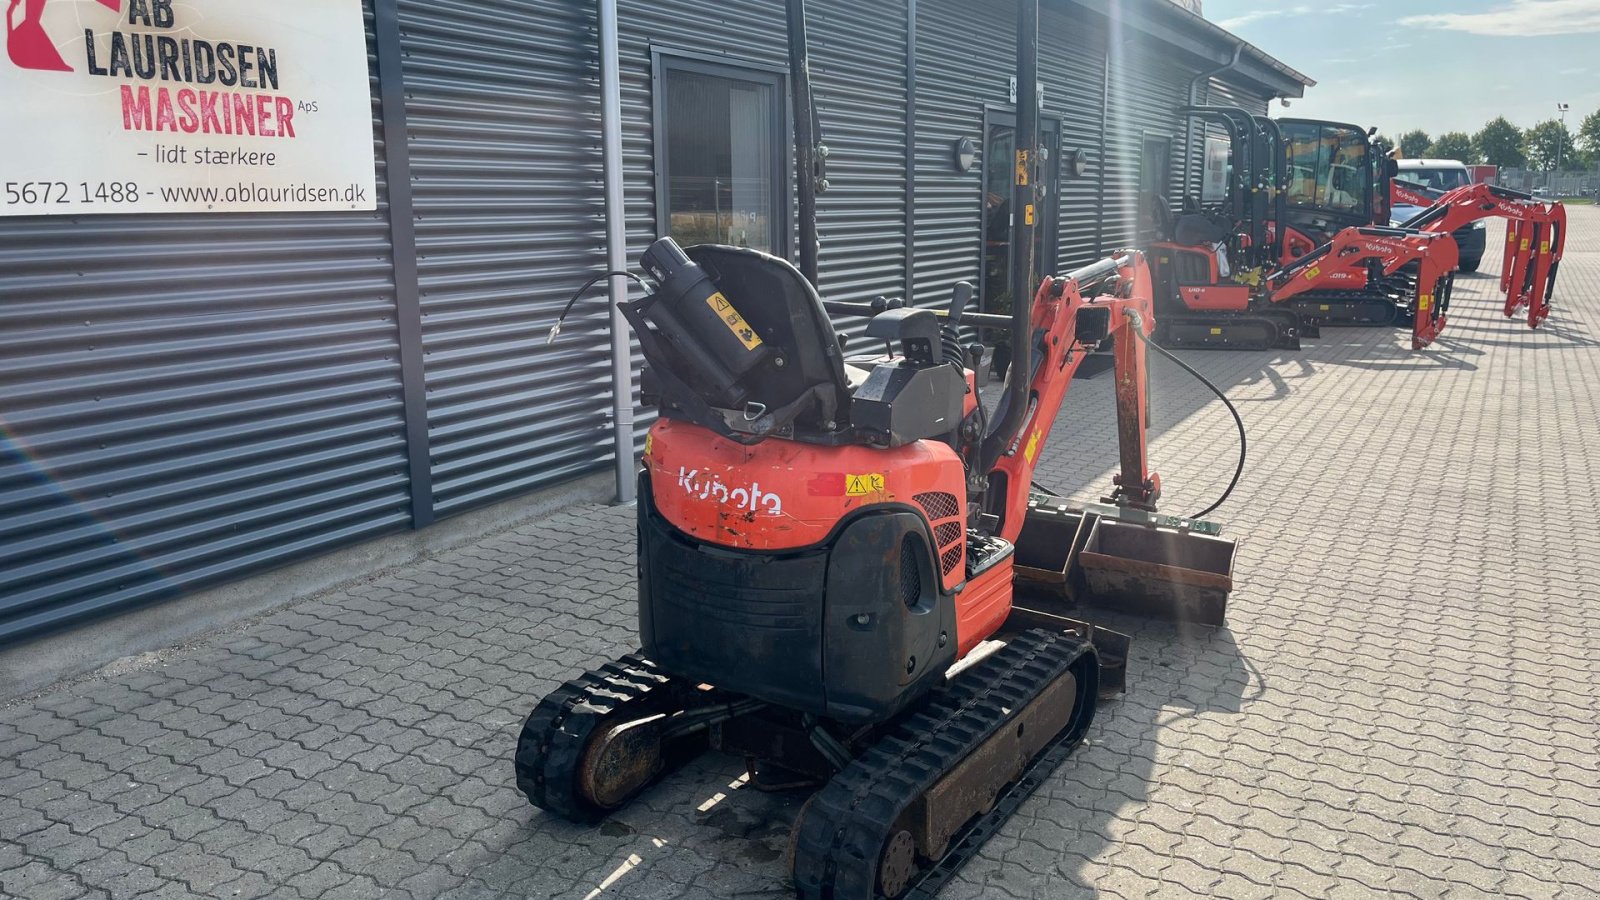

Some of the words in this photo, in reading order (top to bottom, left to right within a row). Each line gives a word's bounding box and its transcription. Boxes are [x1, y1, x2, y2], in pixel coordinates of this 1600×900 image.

[129, 0, 175, 29] AB
[85, 28, 279, 91] LAURIDSEN
[120, 84, 296, 138] MASKINER
[297, 99, 319, 113] ApS
[155, 144, 187, 164] lidt
[194, 146, 276, 166] stærkere
[6, 181, 70, 205] 5672
[79, 181, 140, 204] 1488
[160, 182, 366, 204] www.ablauridsen.dk
[1498, 201, 1523, 217] Kubota
